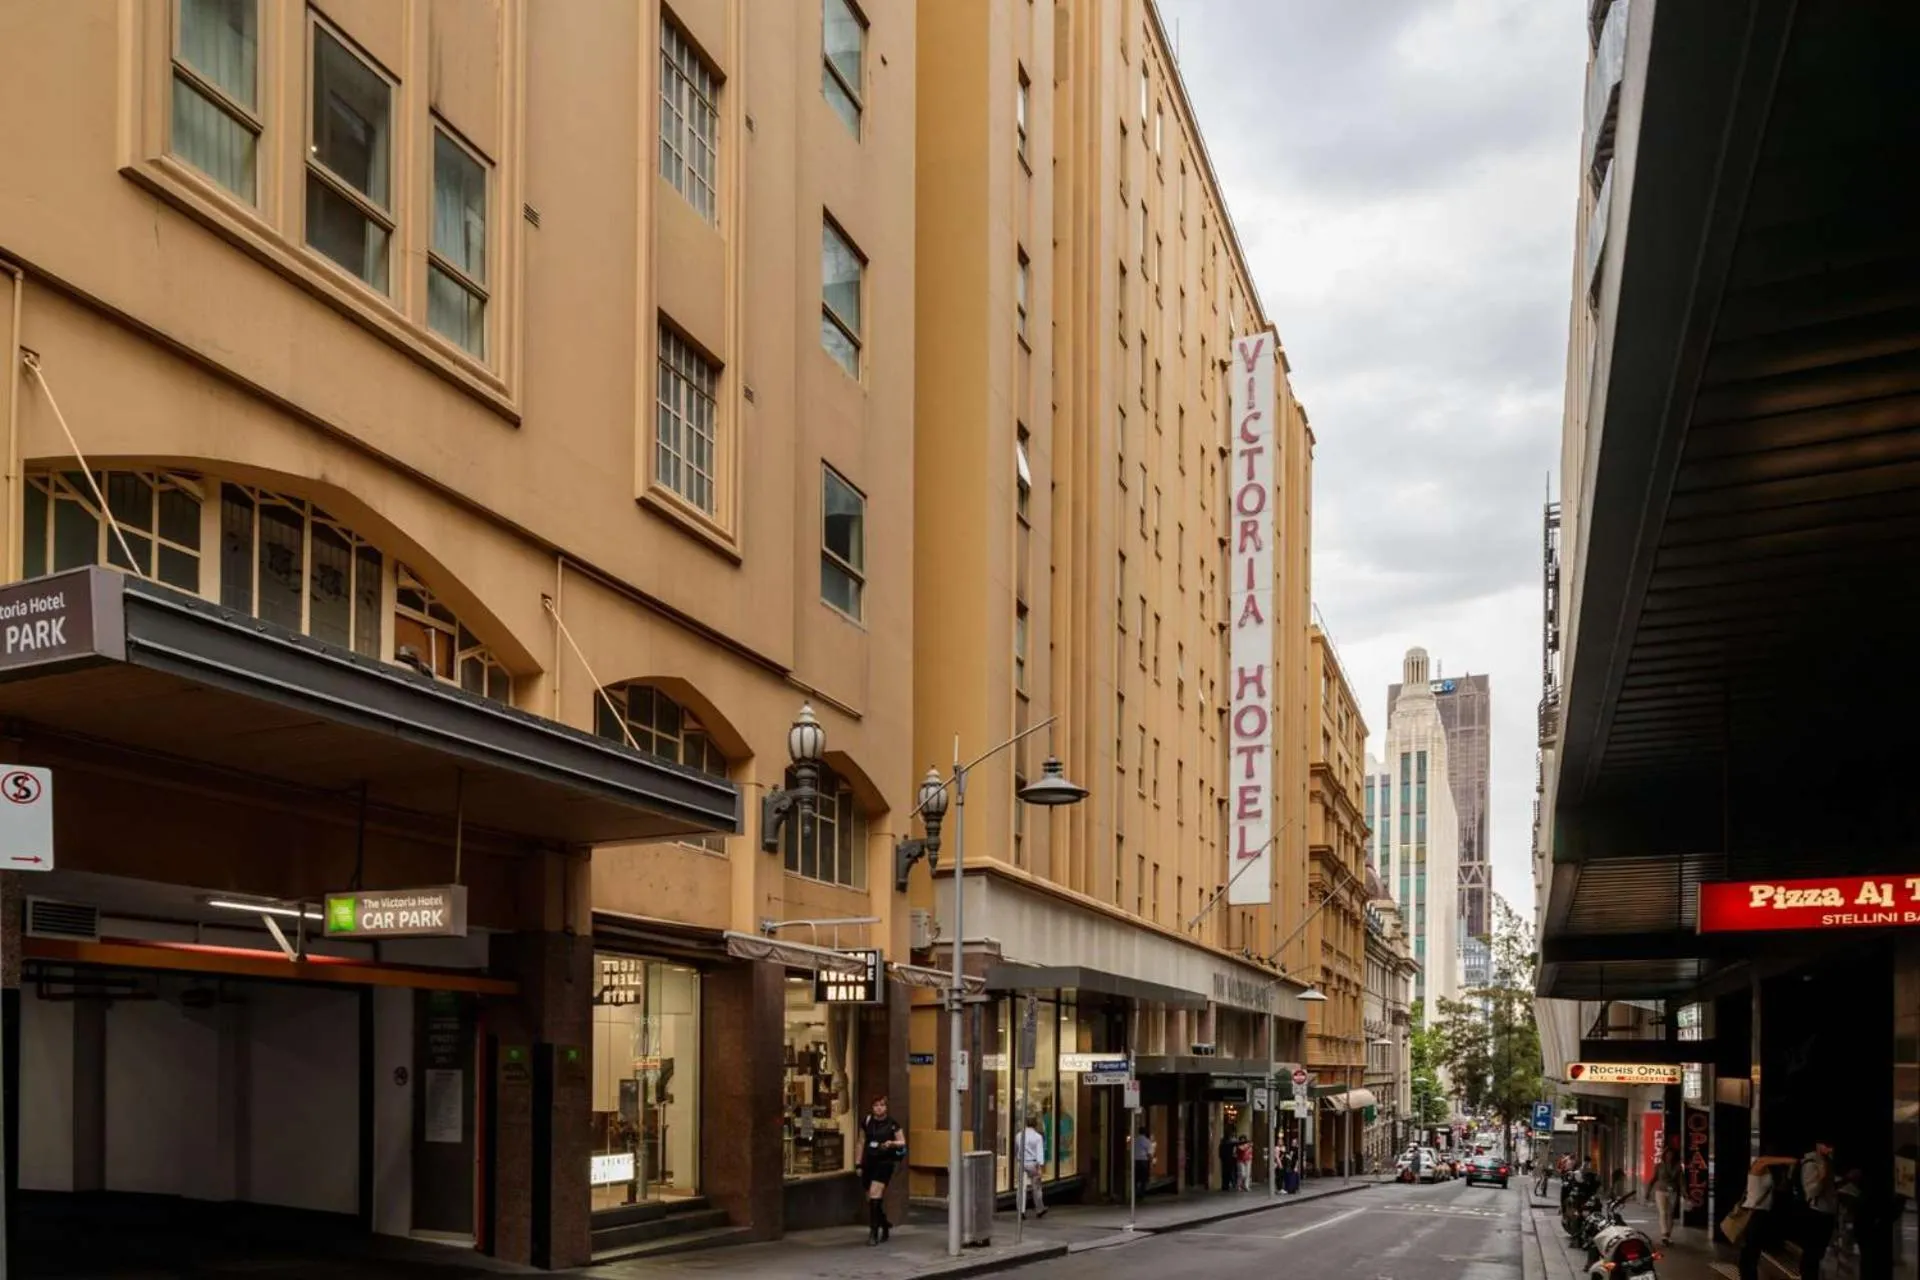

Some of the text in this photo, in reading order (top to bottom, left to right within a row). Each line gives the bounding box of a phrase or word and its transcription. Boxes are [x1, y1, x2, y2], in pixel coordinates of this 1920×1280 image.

[29, 592, 66, 614] Hotel
[1233, 337, 1268, 861] VICTORIA HOTEL
[6, 616, 67, 654] PARK
[363, 895, 443, 909] The Victoria Hotel
[1749, 884, 1846, 909] Pizza
[1853, 881, 1895, 907] Al
[362, 911, 395, 930] CAR
[399, 909, 443, 929] PARK
[1822, 912, 1898, 925] STELLINI
[827, 985, 865, 1001] HAIR
[1637, 1066, 1677, 1076] OPALS
[1536, 1105, 1549, 1118] P
